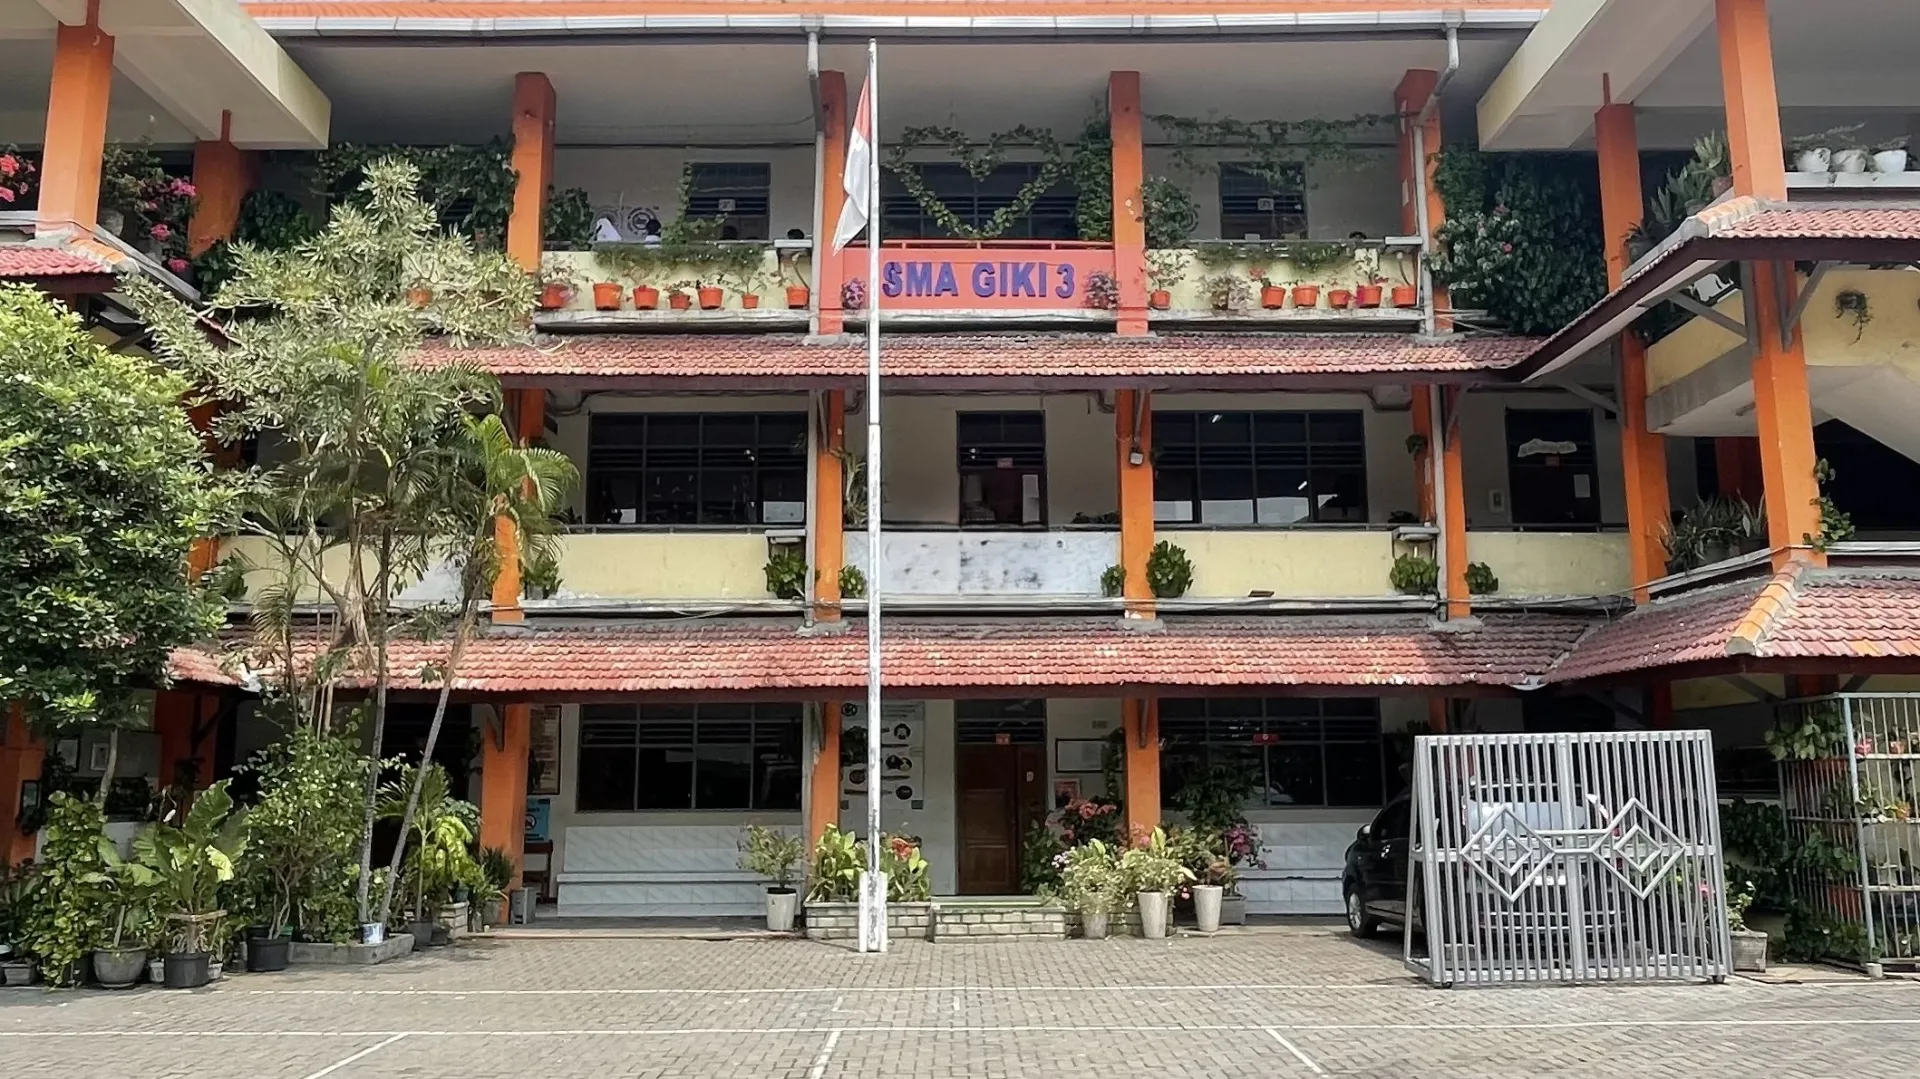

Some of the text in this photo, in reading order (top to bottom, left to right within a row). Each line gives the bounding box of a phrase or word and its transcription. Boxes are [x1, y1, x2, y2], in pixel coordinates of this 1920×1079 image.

[882, 261, 1075, 299] SMA GIKI 3
